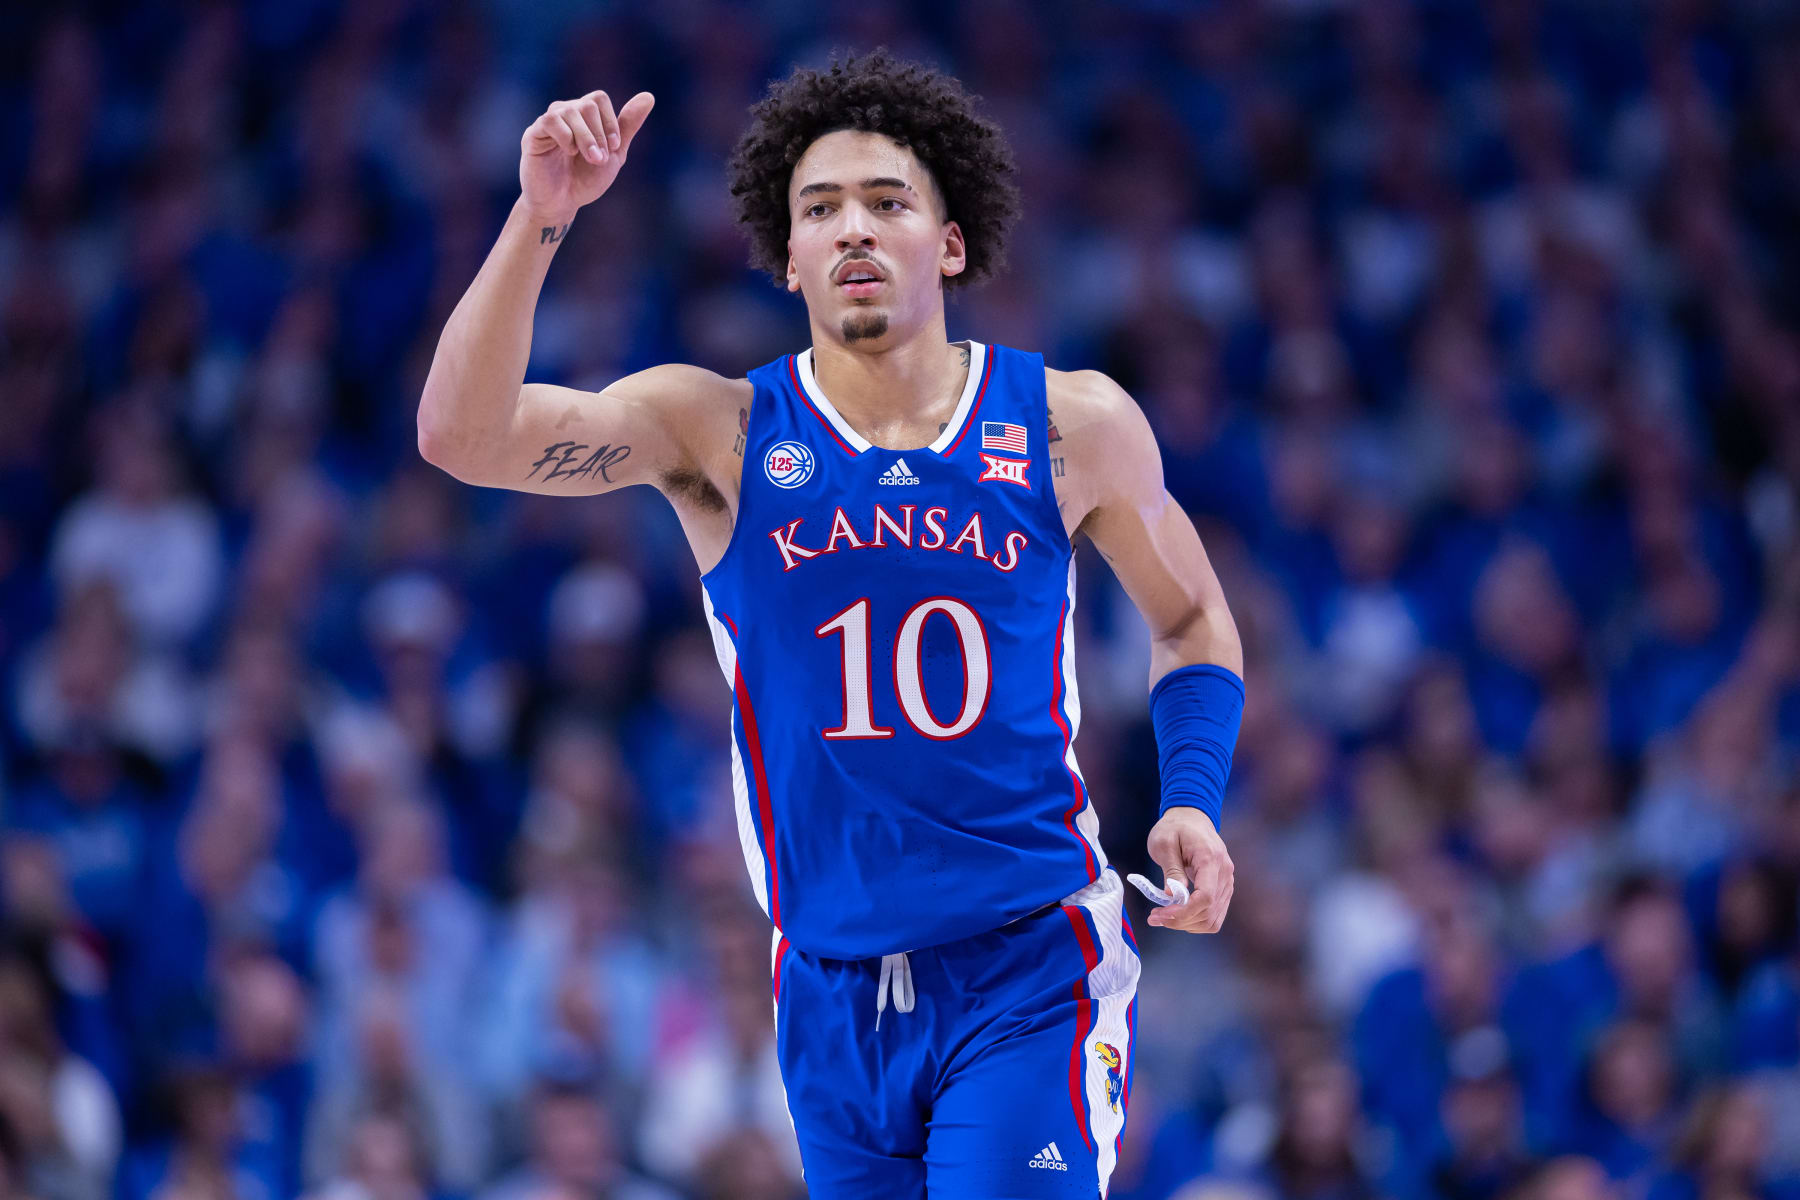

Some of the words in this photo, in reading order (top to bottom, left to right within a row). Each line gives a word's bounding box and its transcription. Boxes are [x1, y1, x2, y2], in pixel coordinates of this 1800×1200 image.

[524, 441, 631, 483] FEAR
[771, 456, 793, 472] 125
[981, 455, 1030, 486] XII
[878, 475, 920, 486] adidas
[769, 503, 1028, 573] KANSAS
[814, 595, 992, 741] 10
[1028, 1158, 1068, 1172] adidas
